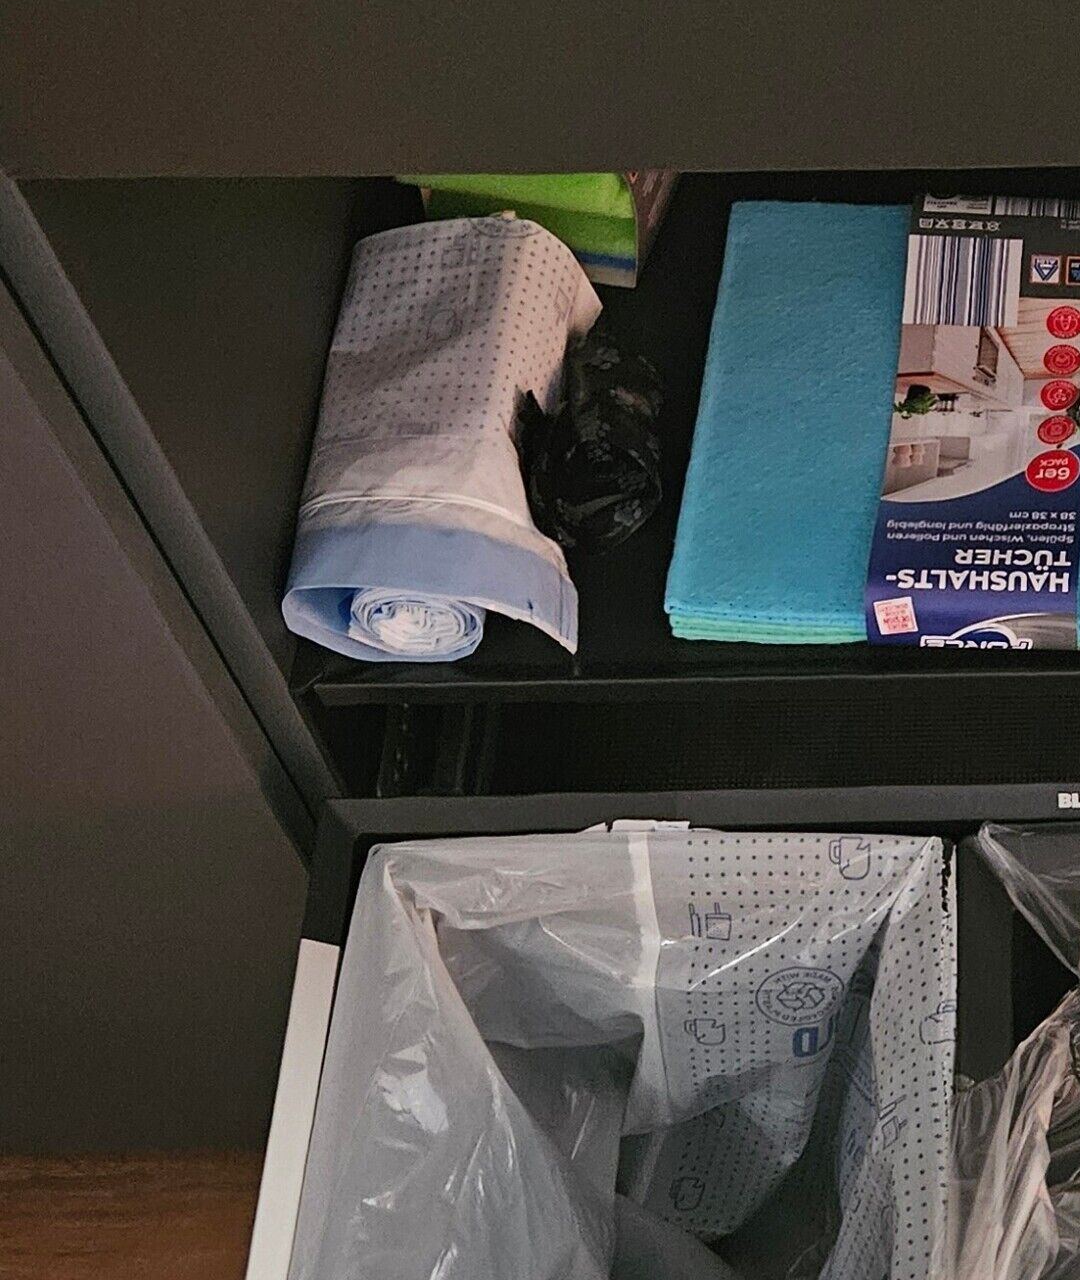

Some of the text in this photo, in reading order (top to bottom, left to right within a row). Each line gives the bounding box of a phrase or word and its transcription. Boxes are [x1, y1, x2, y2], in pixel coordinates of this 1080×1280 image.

[1040, 458, 1068, 467] PACK
[1035, 466, 1070, 480] 6er
[1008, 511, 1030, 519] cm
[1032, 511, 1048, 520] 38
[1060, 512, 1076, 520] 38
[886, 520, 1076, 532] Strapazierfähig und langlebig
[886, 532, 1074, 544] Spülen, Wischen und Polieren
[954, 548, 1072, 571] TÜCHER
[886, 569, 1070, 592] HAUSHALTS-
